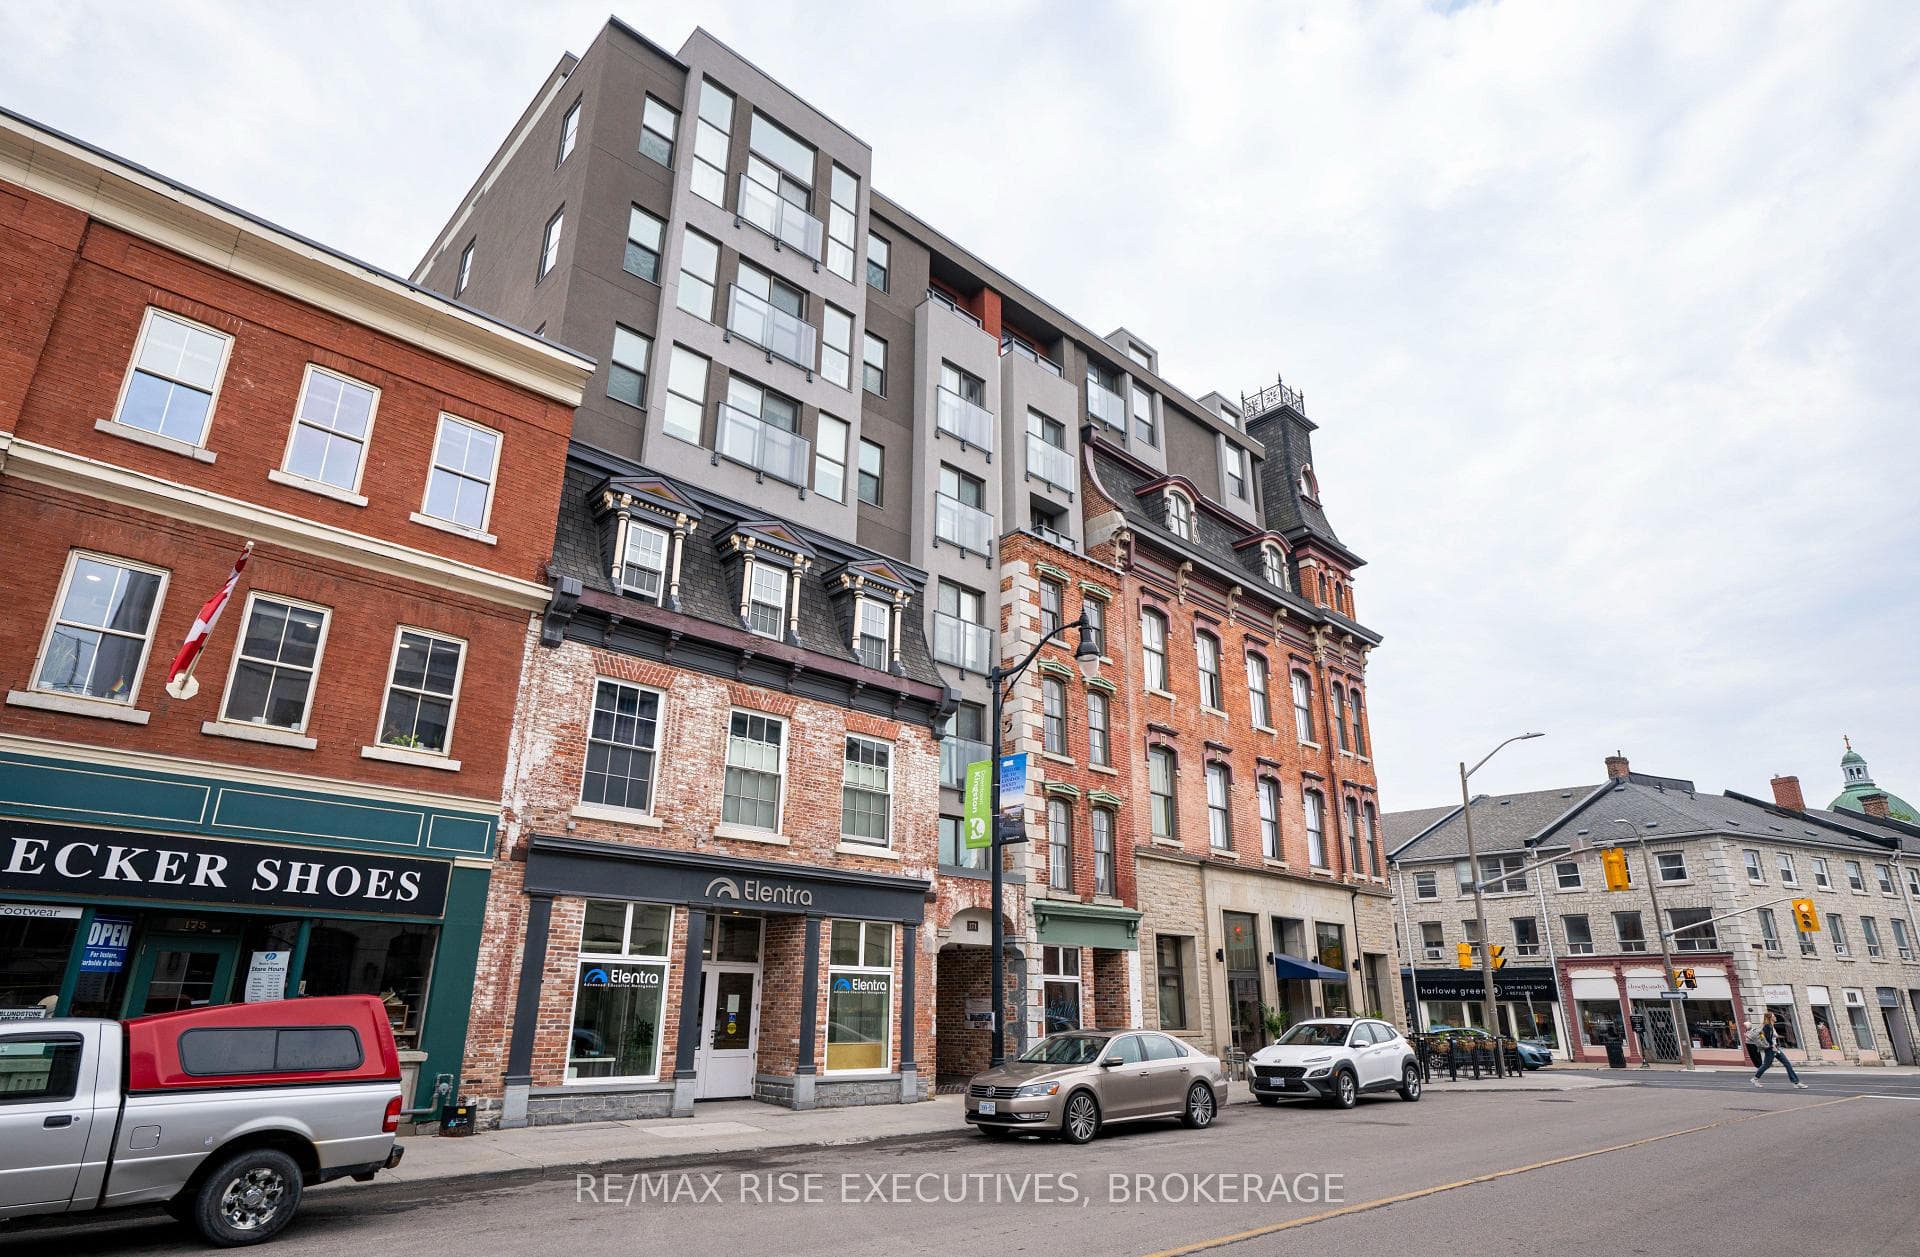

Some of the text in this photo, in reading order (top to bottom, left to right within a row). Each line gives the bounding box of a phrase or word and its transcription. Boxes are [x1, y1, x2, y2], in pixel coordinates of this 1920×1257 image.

[972, 771, 981, 814] Kingston
[1, 837, 422, 901] ECKER SHOES
[744, 879, 813, 906] Elentra
[87, 922, 133, 947] OPEN
[185, 920, 207, 929] 175
[611, 969, 659, 984] Elentra
[852, 978, 887, 991] Elentra
[1421, 986, 1456, 995] harlowe
